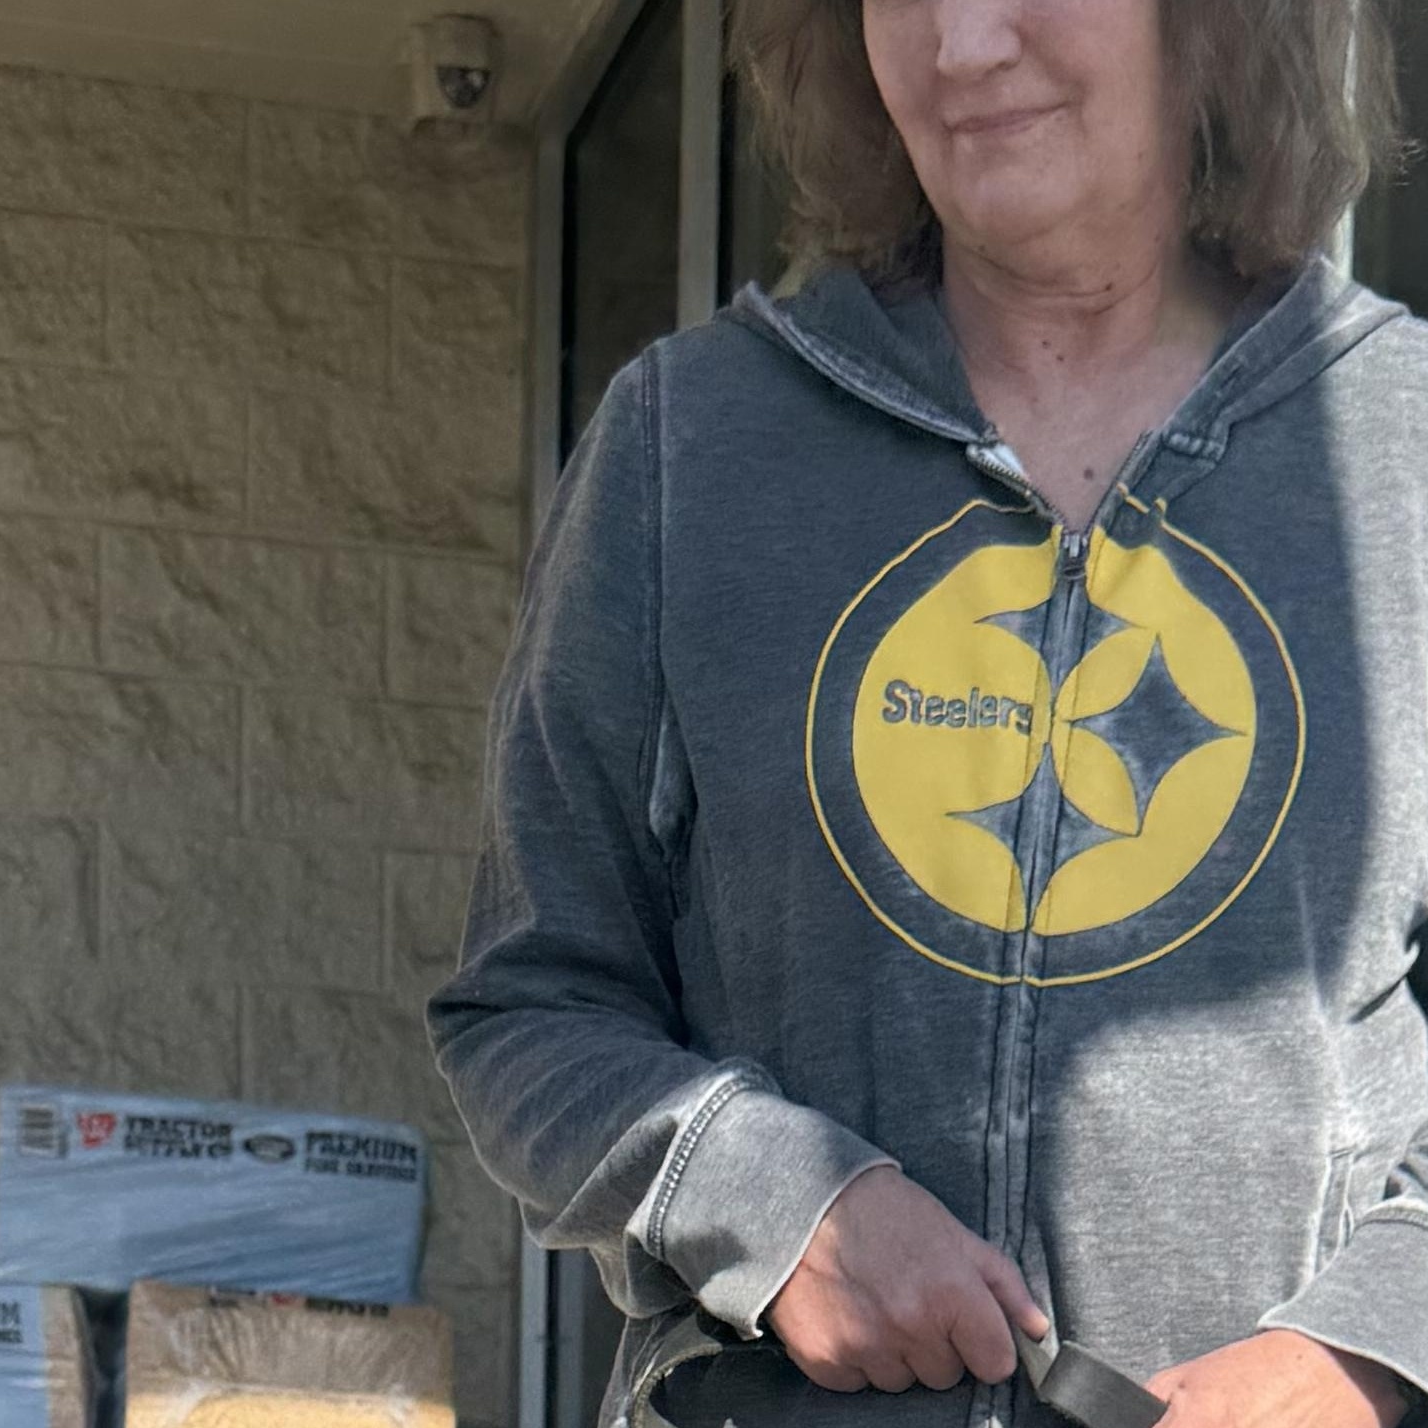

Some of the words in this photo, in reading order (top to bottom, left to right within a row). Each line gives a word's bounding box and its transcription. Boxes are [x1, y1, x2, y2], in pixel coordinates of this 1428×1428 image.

[882, 679, 1034, 736] Steelers
[124, 1115, 233, 1139] TRACTOR
[305, 1130, 418, 1162] PREMIUM
